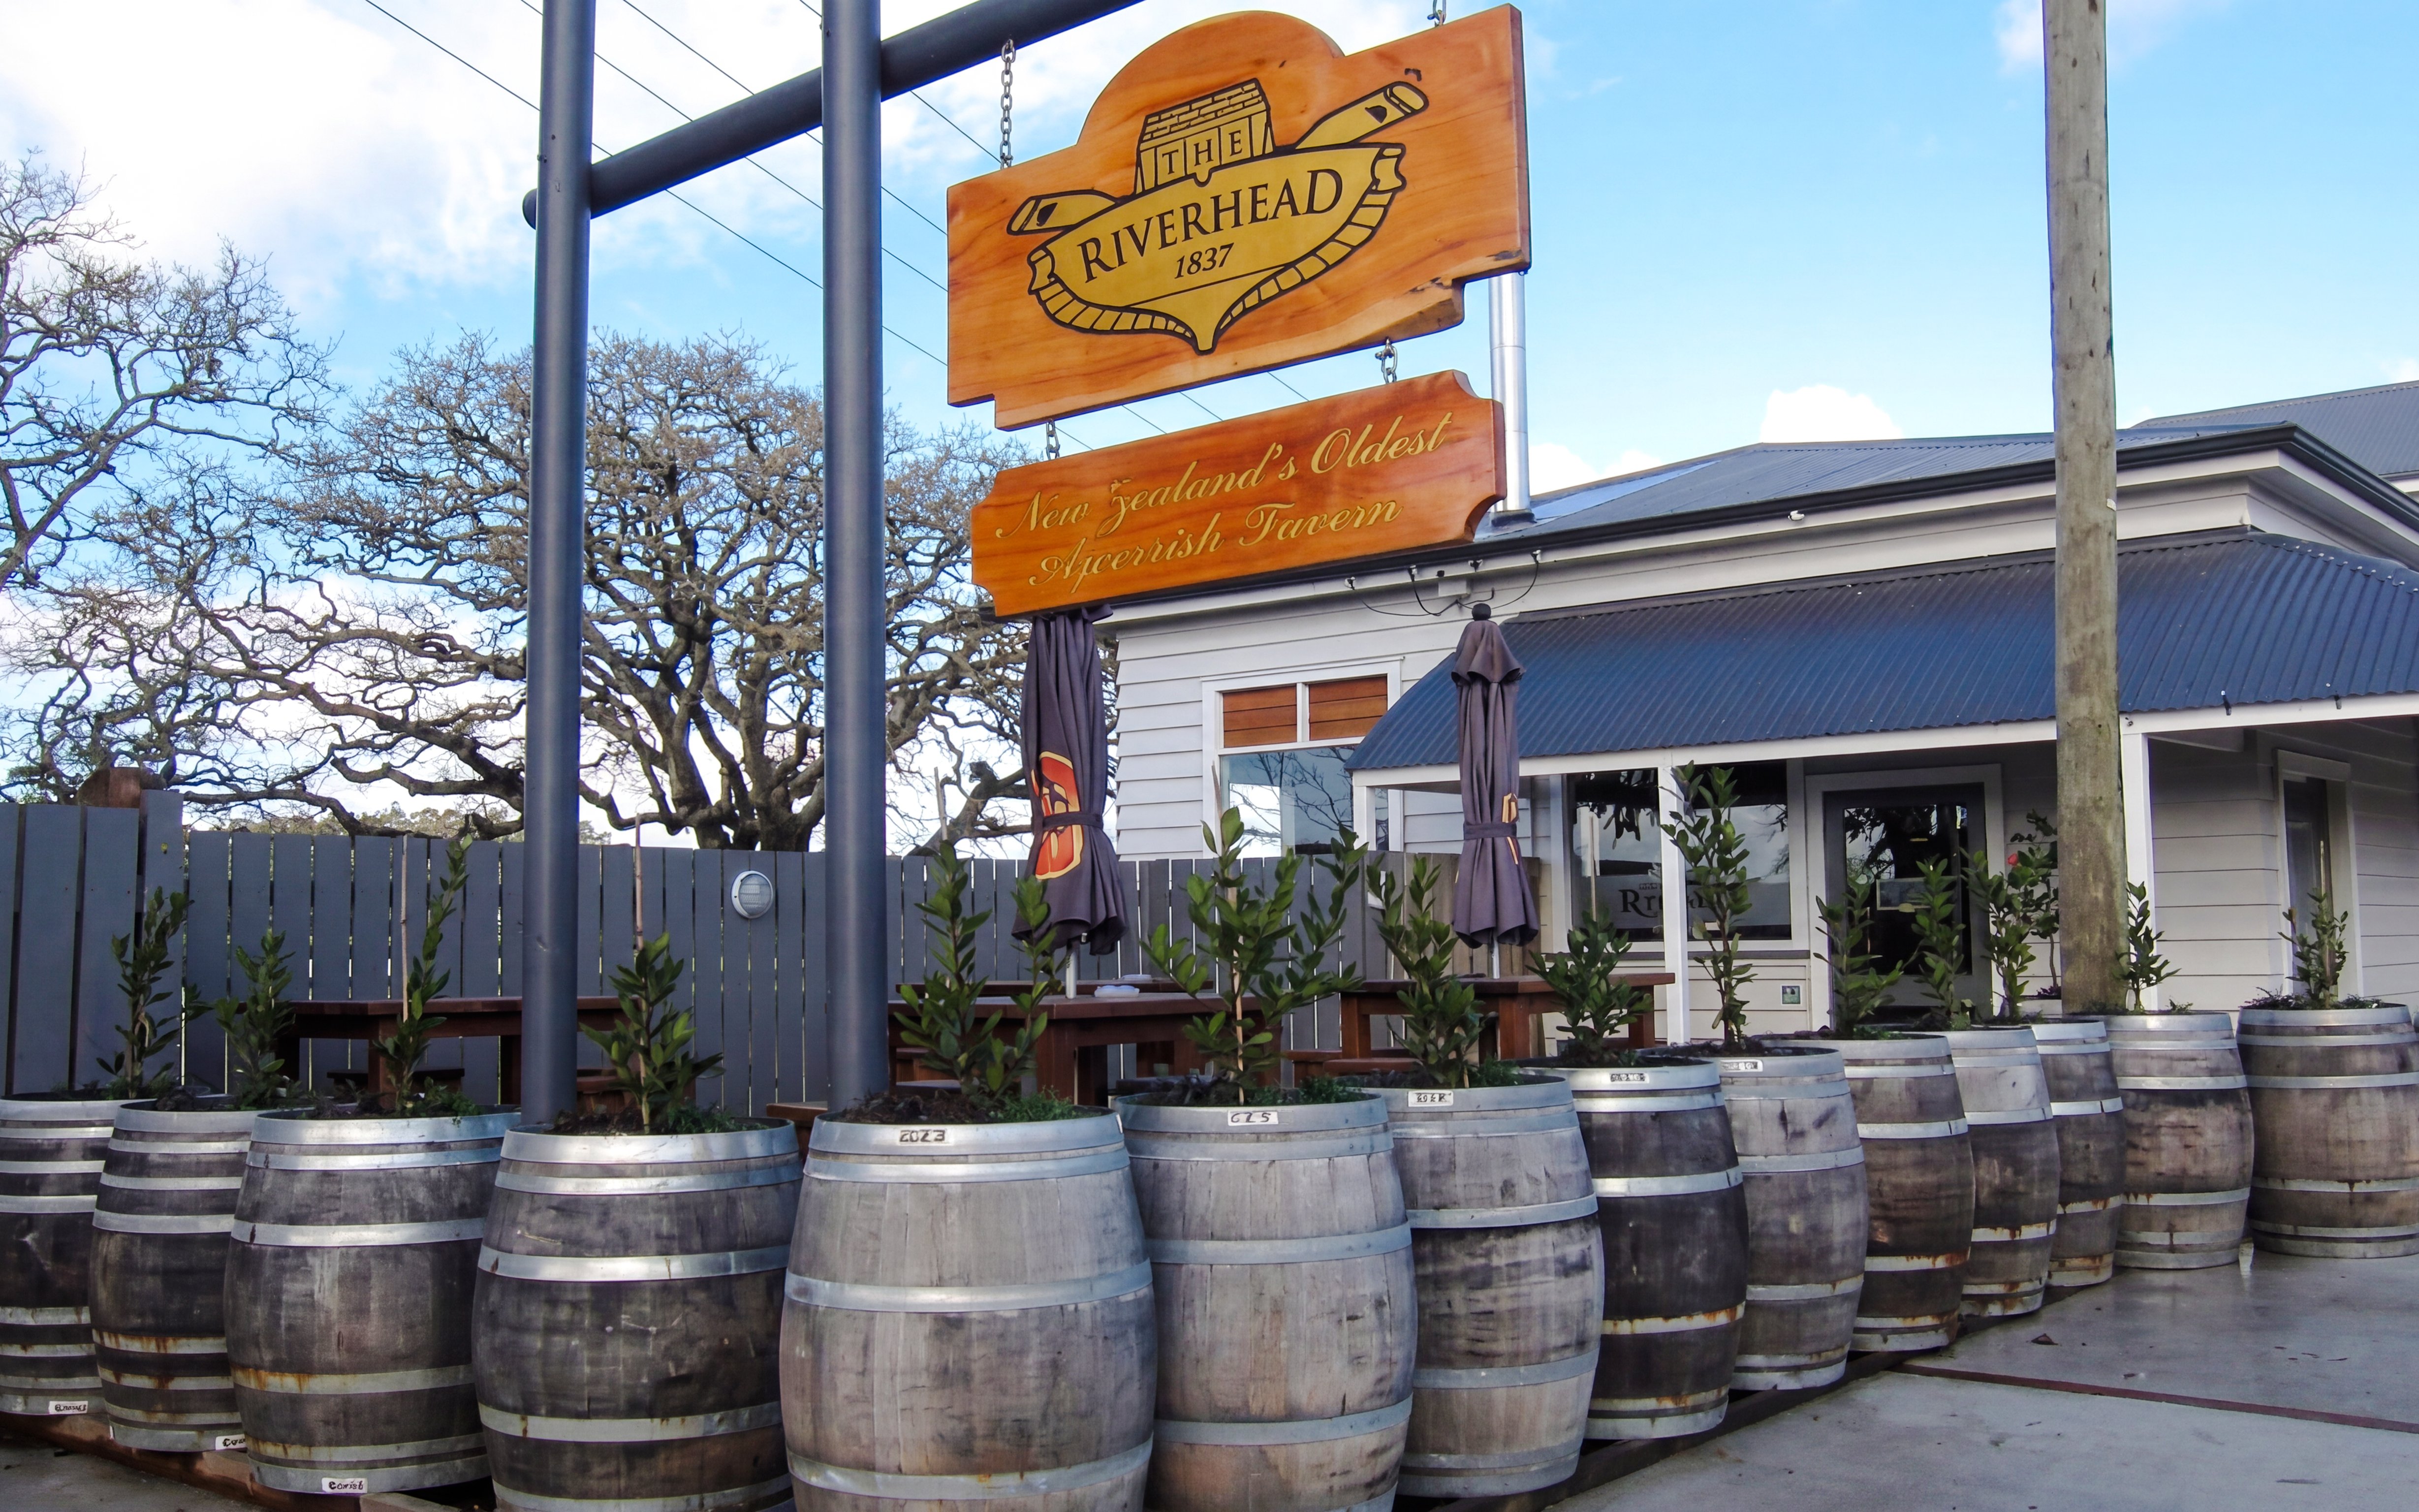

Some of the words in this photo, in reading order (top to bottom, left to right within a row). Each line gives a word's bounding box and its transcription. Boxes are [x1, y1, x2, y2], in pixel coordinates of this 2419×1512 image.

[1161, 131, 1243, 176] THE
[1077, 168, 1343, 283] RIVERHEAD
[1174, 243, 1234, 280] 1837
[995, 491, 1092, 539] New
[1096, 442, 1298, 537] Zealand's
[1311, 411, 1453, 474] Oldest
[1239, 499, 1403, 546] Tavern
